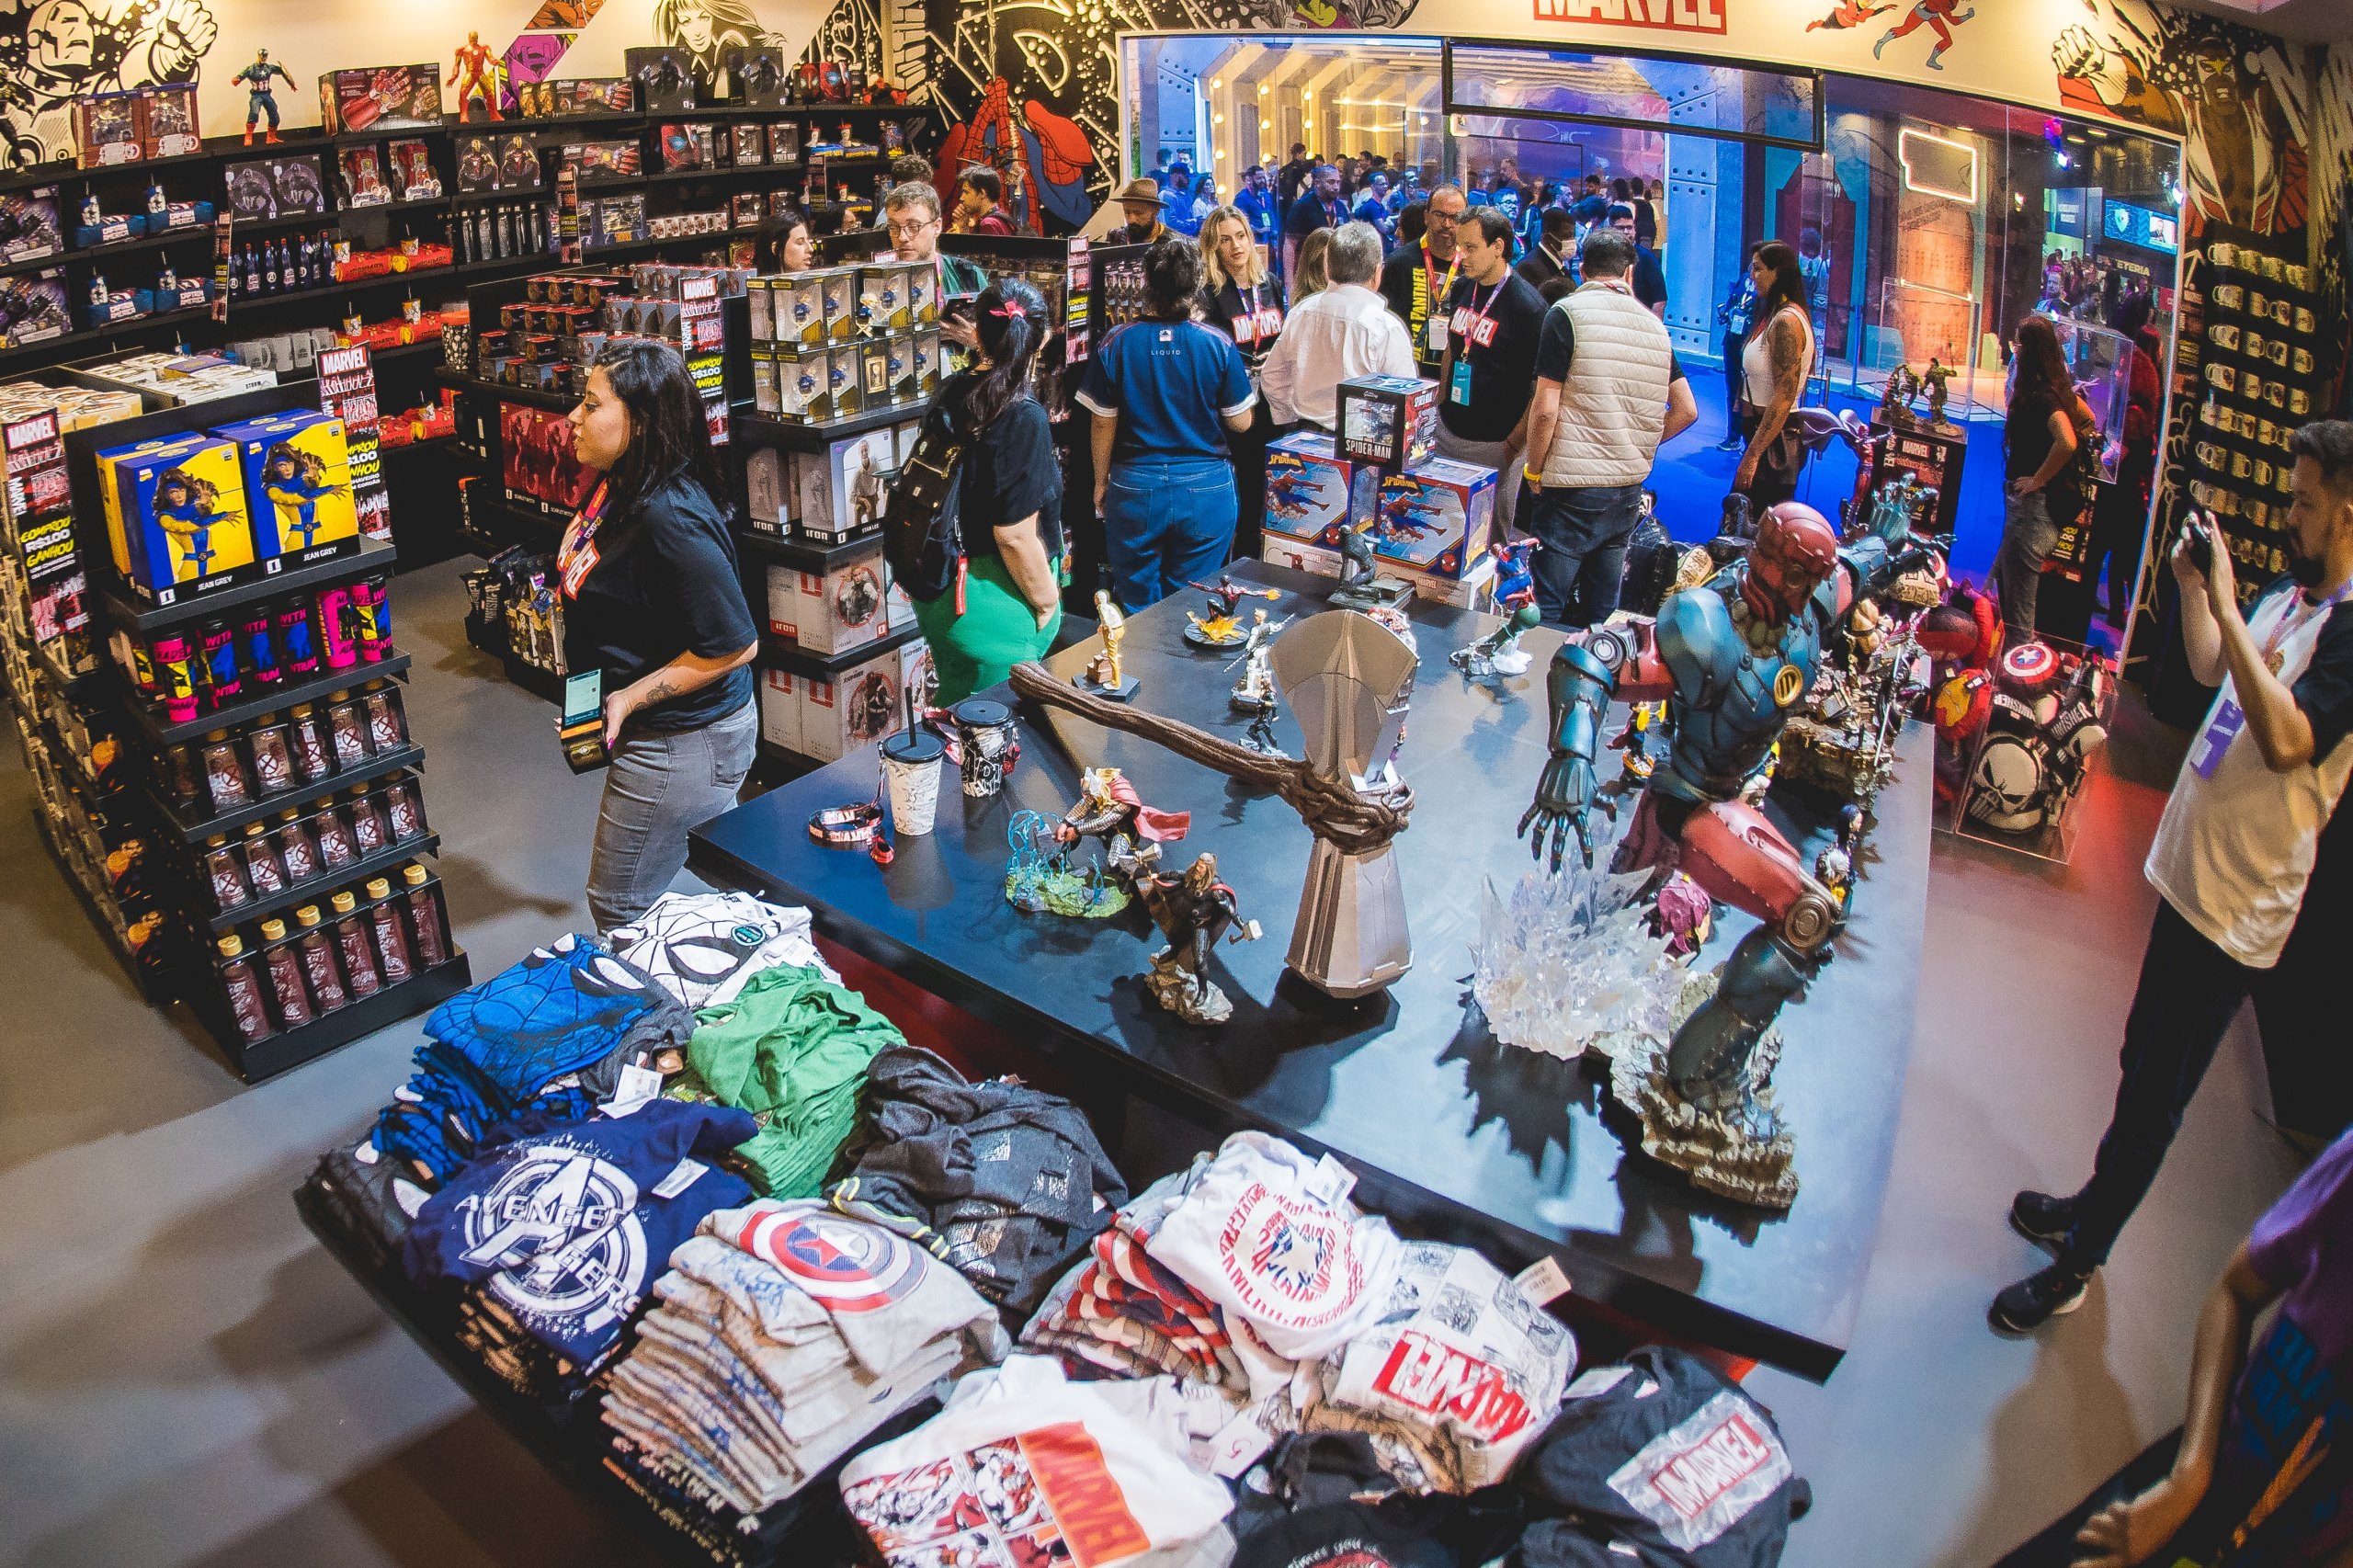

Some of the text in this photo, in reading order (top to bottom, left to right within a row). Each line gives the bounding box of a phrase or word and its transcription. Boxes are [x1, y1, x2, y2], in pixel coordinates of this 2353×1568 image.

[684, 279, 715, 301] MARVEL
[1411, 267, 1427, 321] PANTHER
[323, 348, 367, 375] MARVEL
[8, 417, 55, 449] MARVEL
[347, 437, 379, 456] MPROU
[1346, 439, 1392, 460] SPIDER-MAN
[1902, 440, 1929, 458] MARVEL
[350, 460, 380, 477] NHOU
[9, 476, 27, 516] MARVEL
[20, 516, 72, 543] COMPROU
[25, 528, 71, 553] R$100
[27, 539, 74, 568] GANHOU
[303, 546, 337, 562] JEAN GREY
[1303, 551, 1323, 563] MARVEL
[198, 574, 233, 592] JEAN GREY
[1418, 576, 1438, 589] MARVEL
[206, 630, 232, 647] WITH
[1993, 693, 2036, 722] UNISHER
[2051, 701, 2093, 741] UNISHER
[1654, 1419, 1771, 1517] MARVEL
